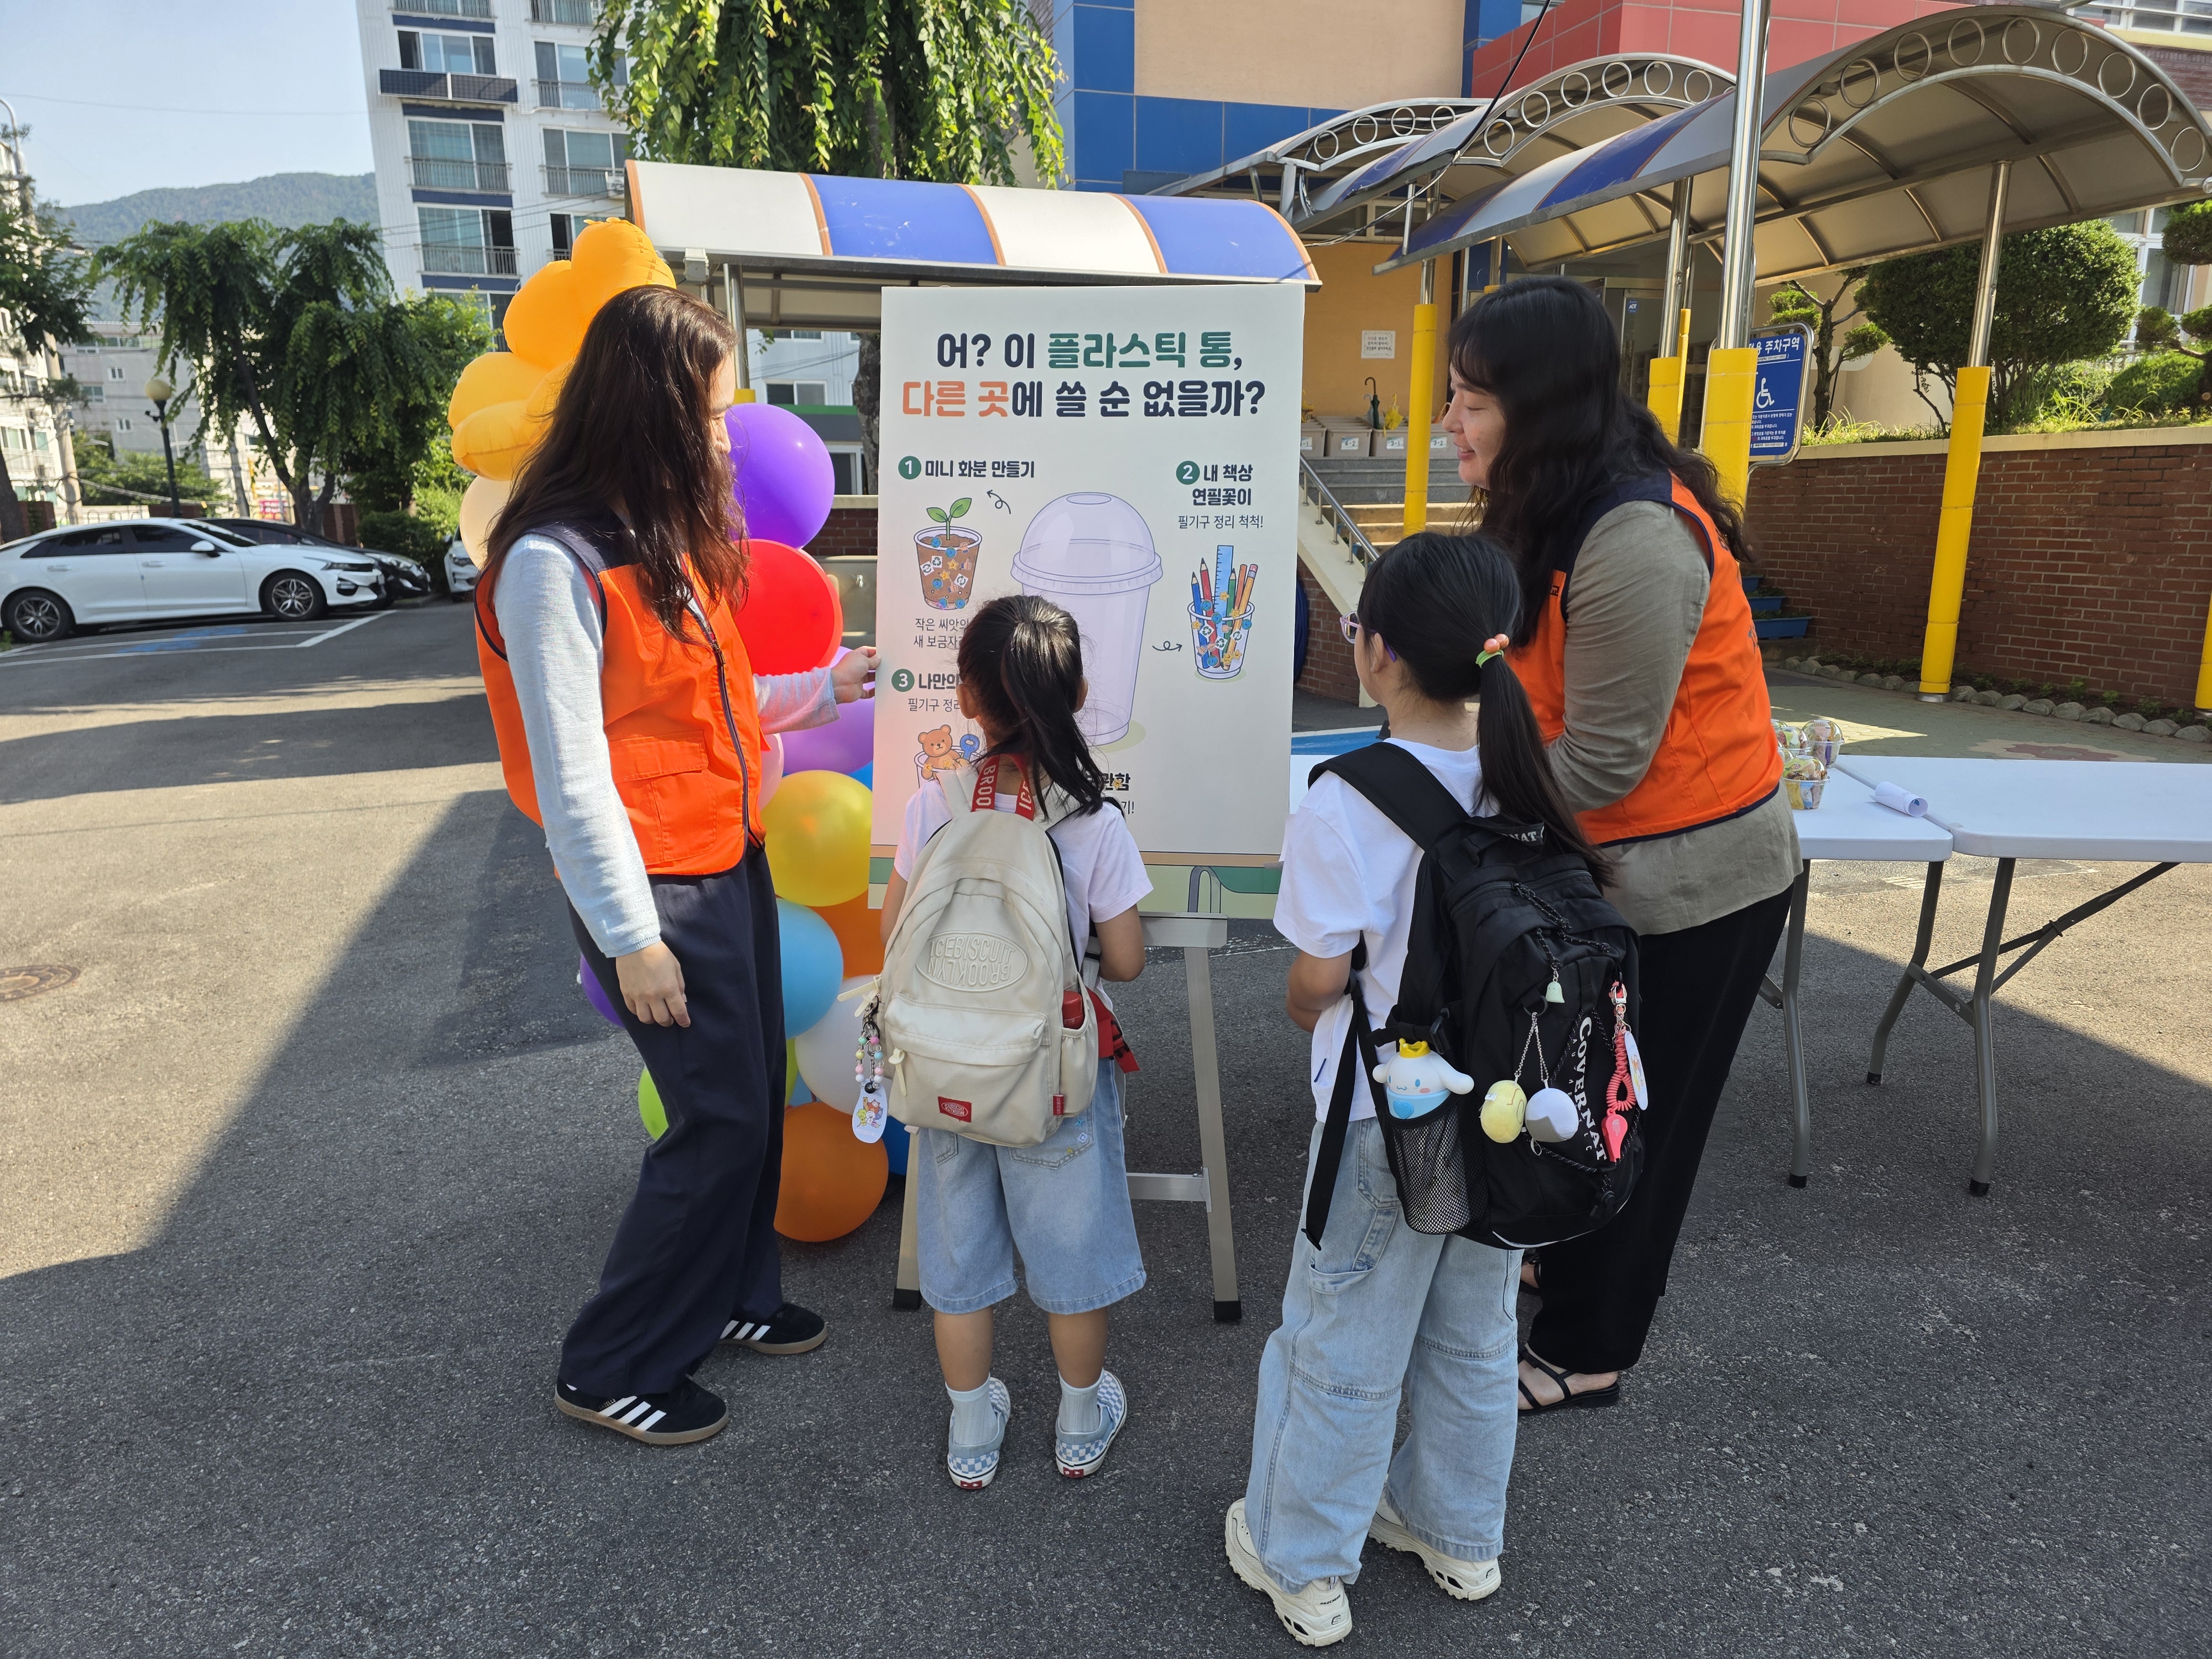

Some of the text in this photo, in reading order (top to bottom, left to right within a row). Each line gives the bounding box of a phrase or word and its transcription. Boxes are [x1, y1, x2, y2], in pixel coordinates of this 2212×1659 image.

[937, 331, 1242, 371] 어? 이 플라스틱 통,
[1765, 337, 1800, 354] 주차구역
[902, 379, 1265, 418] 다른 곳에 쓸 순 없을까?
[925, 460, 954, 478] 미니
[958, 460, 987, 478] 화분
[991, 460, 1035, 478] 만들기
[1203, 464, 1218, 482] 내
[1223, 464, 1254, 482] 책상
[1178, 515, 1263, 529] 필기구 정리 척척!
[915, 618, 936, 632] 작은
[913, 634, 960, 649] 새 보금자
[907, 698, 940, 712] 필기구
[975, 765, 997, 811] BROO
[930, 936, 1015, 963] ICEBISCUIT
[928, 957, 1011, 987] BROOKLYN
[1574, 1016, 1608, 1161] COVERNAT
